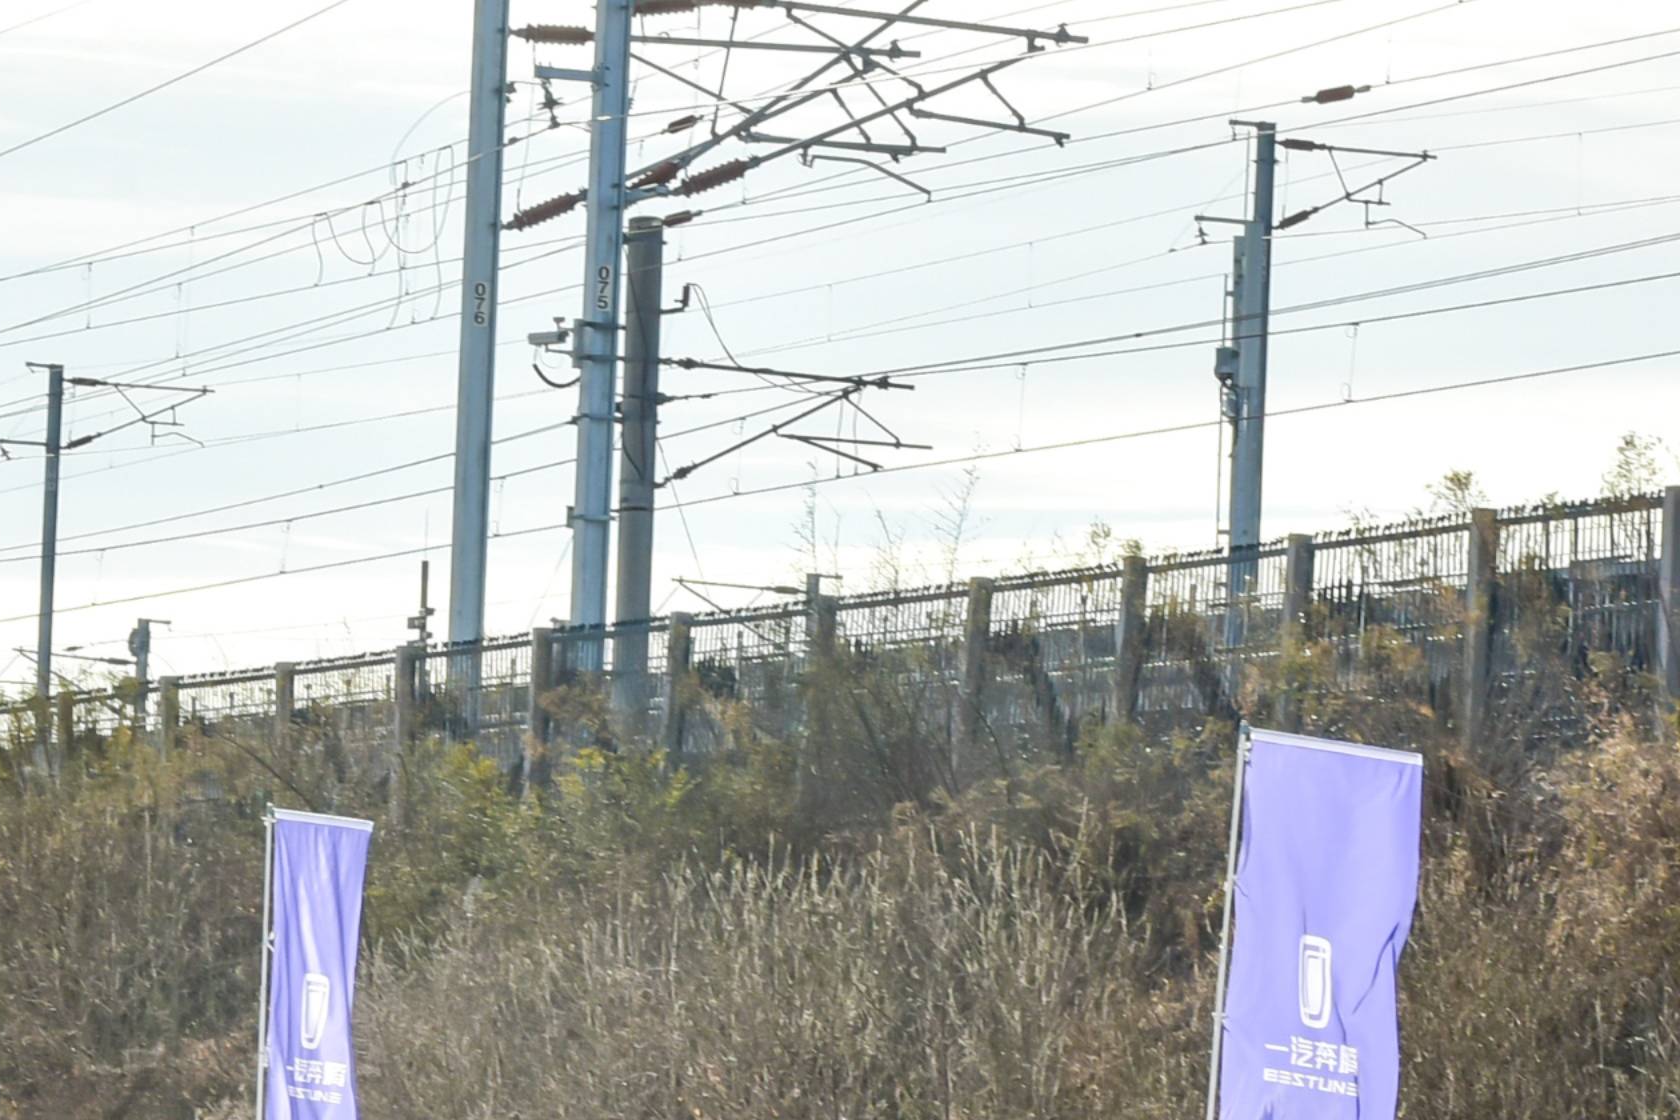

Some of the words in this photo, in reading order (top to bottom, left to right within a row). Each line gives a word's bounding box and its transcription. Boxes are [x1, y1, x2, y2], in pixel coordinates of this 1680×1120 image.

[473, 282, 486, 324] 076
[597, 265, 610, 310] 075
[1263, 1067, 1358, 1098] BESTUNE
